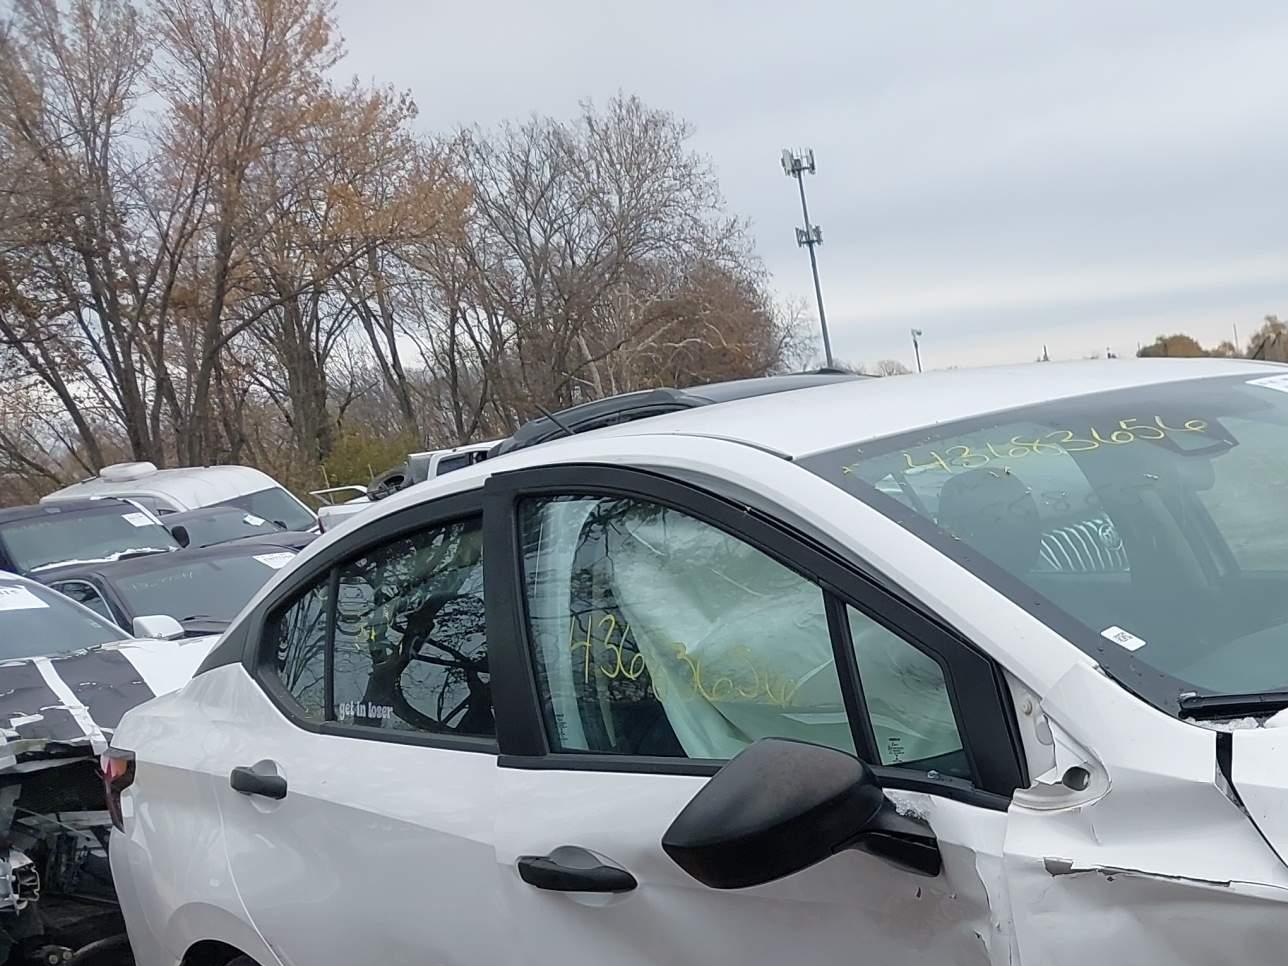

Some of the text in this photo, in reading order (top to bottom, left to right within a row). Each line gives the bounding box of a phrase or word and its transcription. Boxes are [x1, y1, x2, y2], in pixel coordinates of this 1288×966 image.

[903, 415, 1208, 475] 43683656
[569, 614, 798, 708] 4363656
[339, 701, 393, 721] get in loser
